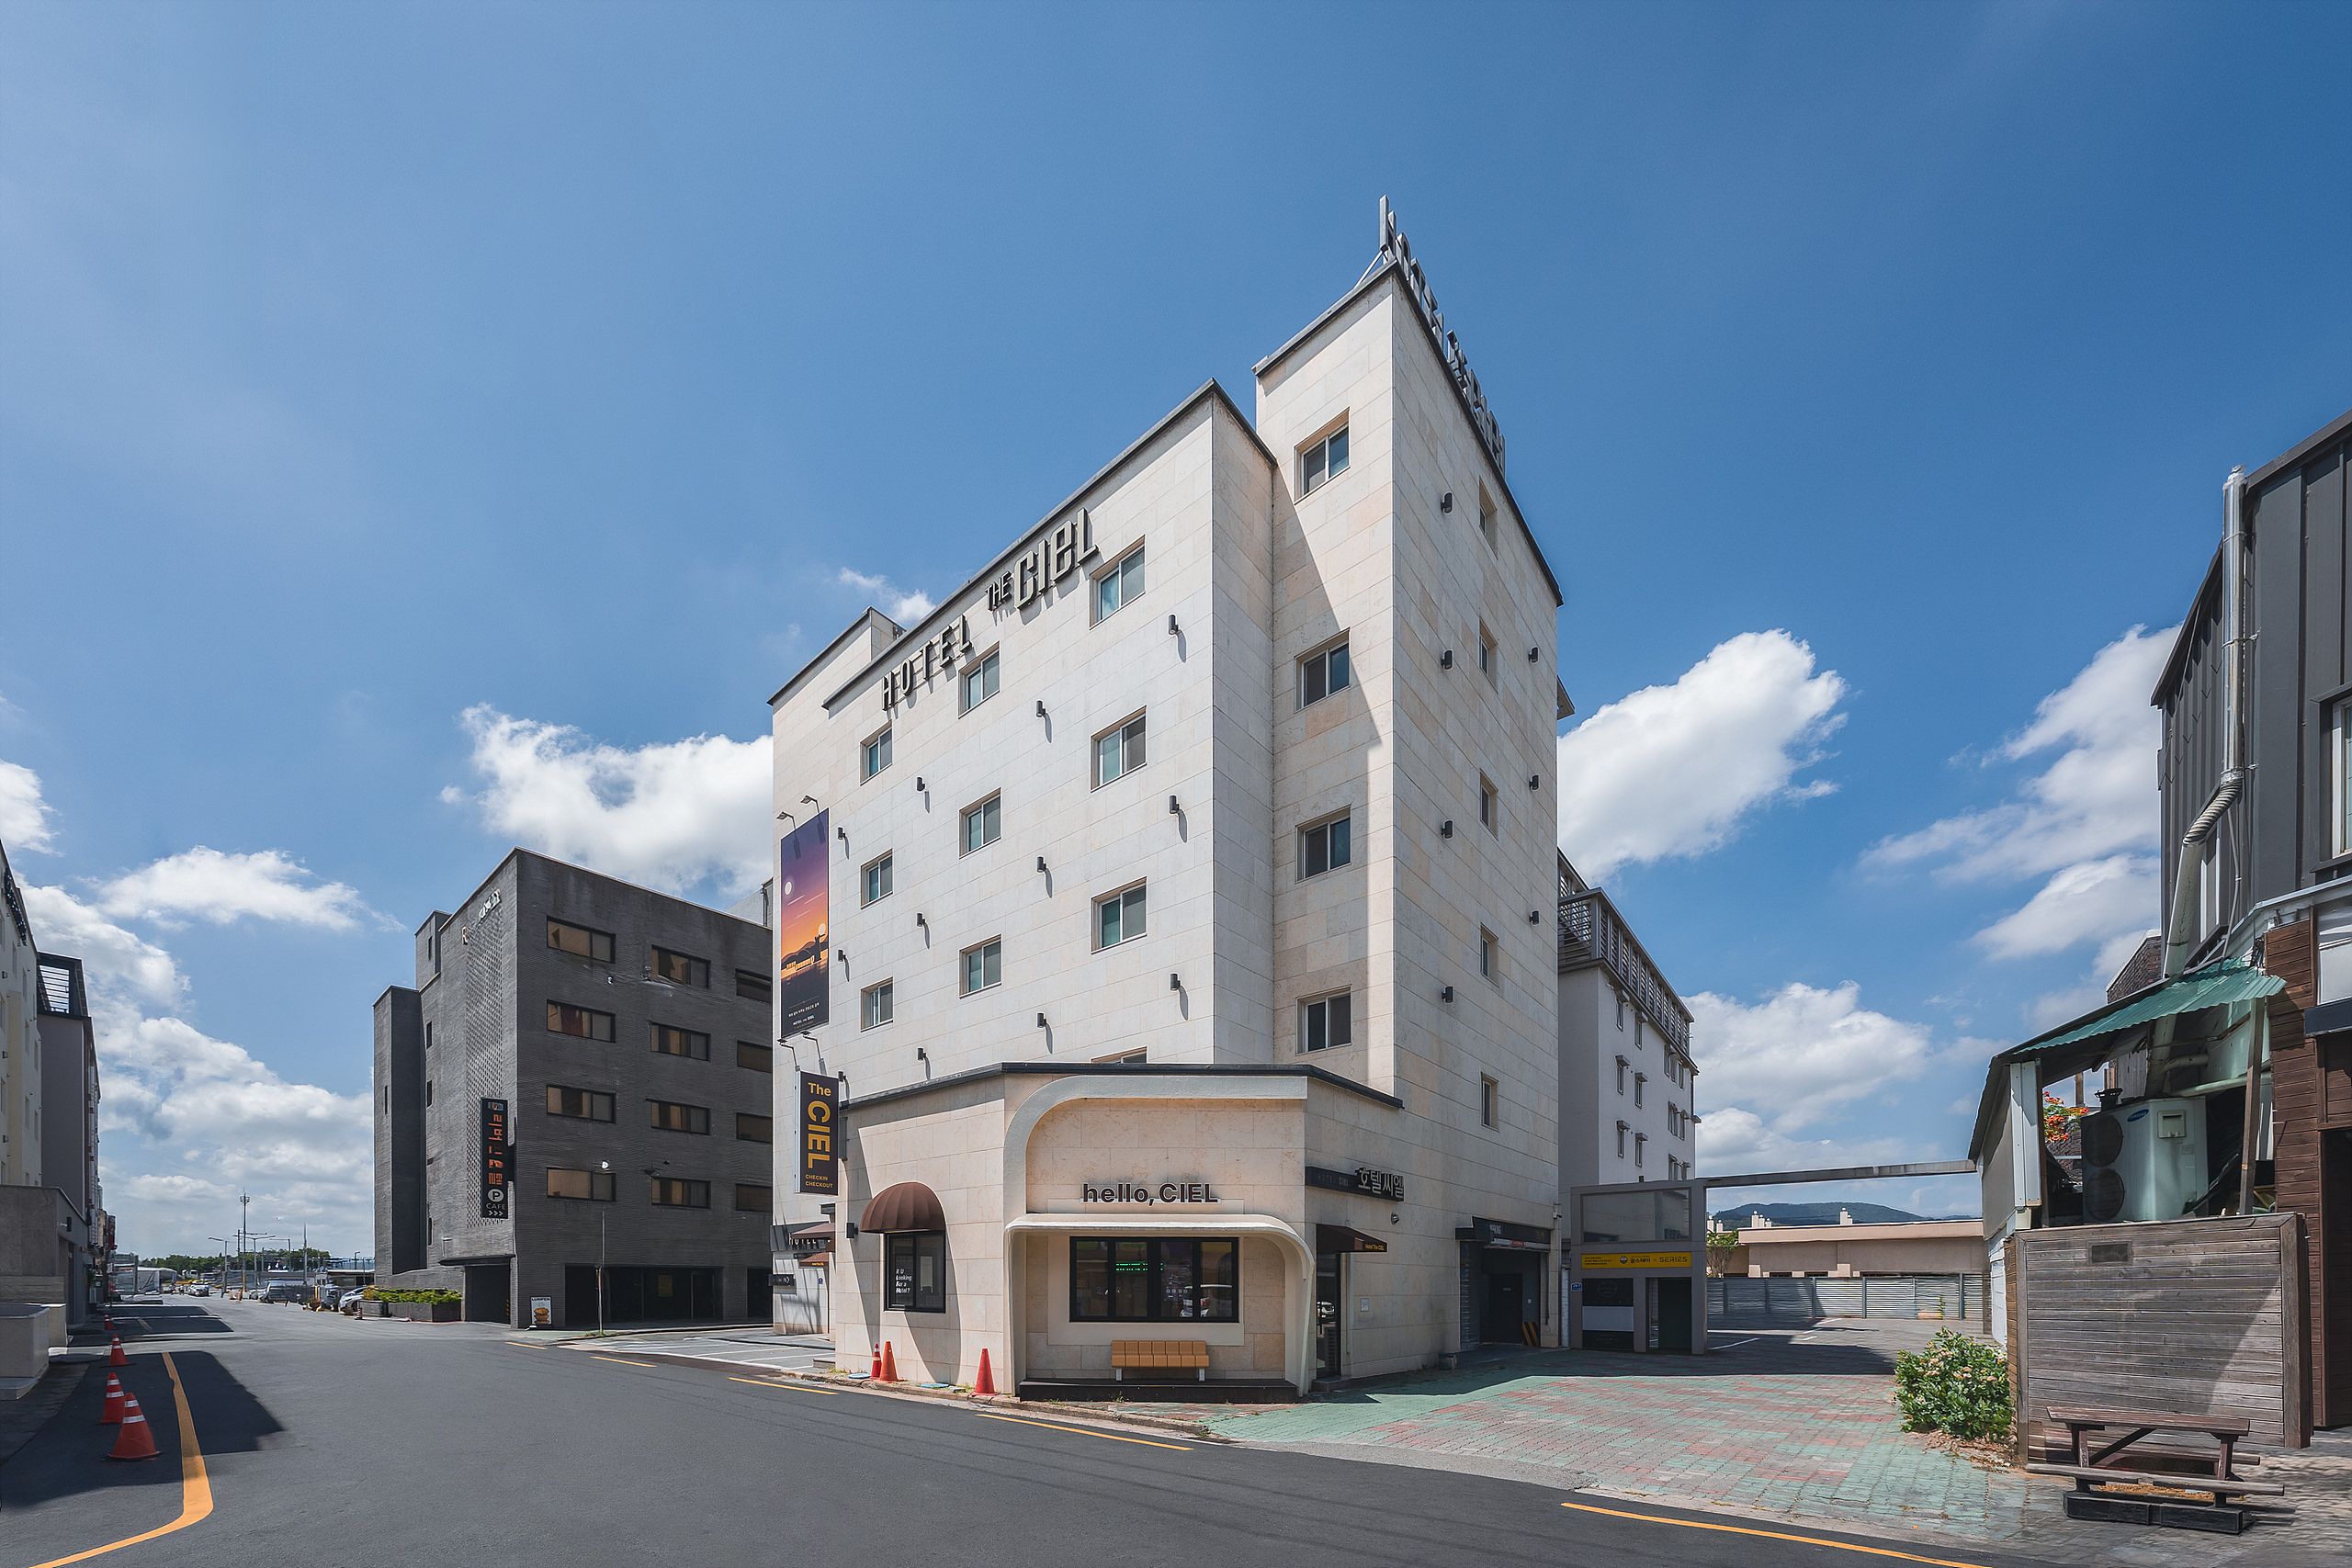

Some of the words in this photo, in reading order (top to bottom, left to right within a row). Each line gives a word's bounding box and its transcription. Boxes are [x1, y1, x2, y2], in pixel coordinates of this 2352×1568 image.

[882, 614, 973, 712] HOTEL
[985, 570, 1012, 612] THE
[808, 1082, 831, 1097] The
[808, 1100, 831, 1168] CIEL
[1358, 1168, 1404, 1199] 호텔씨엘
